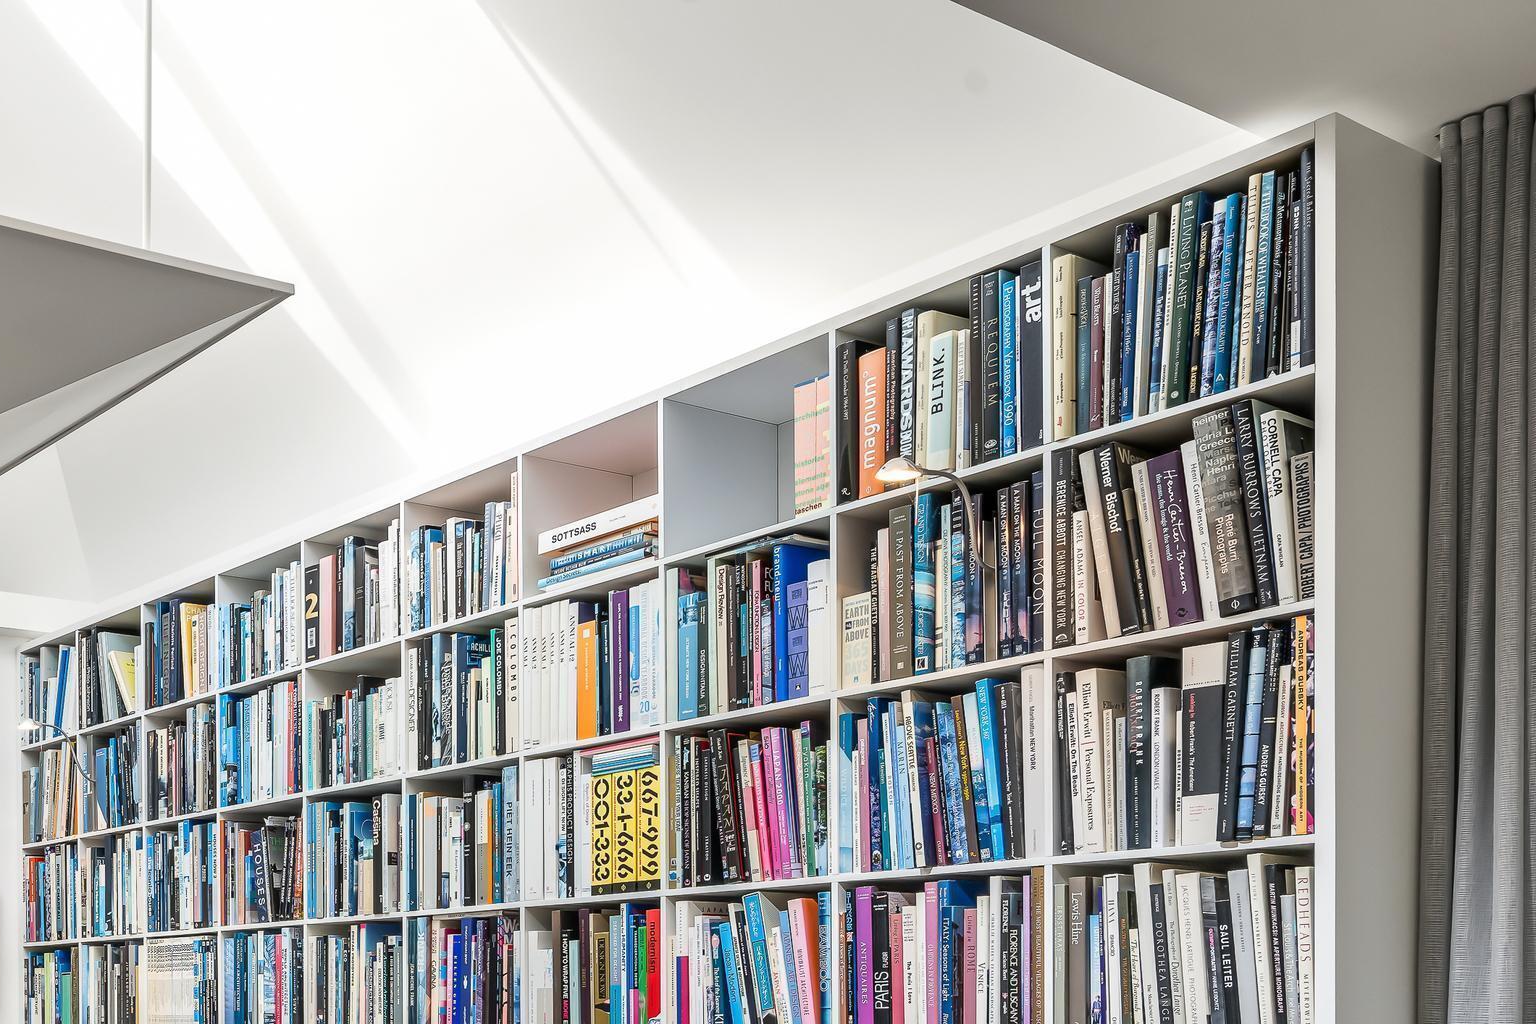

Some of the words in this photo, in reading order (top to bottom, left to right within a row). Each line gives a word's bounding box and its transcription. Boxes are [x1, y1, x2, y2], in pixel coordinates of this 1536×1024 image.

[1248, 185, 1257, 231] TULIPS
[1246, 250, 1254, 290] PETER
[1003, 286, 1012, 349] PHOTOGRAPHY
[1242, 295, 1253, 346] ARNOLD
[931, 347, 945, 415] BLINK.
[987, 317, 998, 406] REQUIEM
[1003, 350, 1013, 398] YEARBOOK
[1004, 401, 1014, 426] 1990
[1237, 409, 1252, 448] LARRY
[1099, 448, 1113, 488] Werner
[1243, 453, 1262, 518] BURROWS
[795, 502, 822, 515] taschen
[1105, 491, 1122, 534] Bischof
[1296, 462, 1312, 529] PHOTOGRAPHS
[551, 522, 597, 545] SOTTSASS
[1033, 509, 1044, 550] FULL
[1226, 513, 1235, 534] René
[1215, 517, 1228, 575] Photographs
[1227, 537, 1238, 562] Burri
[1252, 524, 1269, 586] VIETNAM
[1300, 538, 1313, 565] CAPA
[1032, 559, 1044, 616] MOON
[1302, 567, 1314, 600] ROBERT
[306, 593, 318, 620] 2
[845, 605, 869, 619] EARTH
[853, 619, 869, 630] FROM
[1078, 592, 1086, 621] COLOR
[845, 628, 869, 642] ABOVE
[1068, 703, 1076, 726] Elliott
[372, 799, 380, 846] Cassina
[253, 843, 266, 907] HOUSES
[1219, 924, 1229, 951] SAUL
[1297, 877, 1311, 963] REDHEADS
[819, 925, 827, 994] BAMBOO
[977, 962, 985, 994] VENICE
[1221, 954, 1233, 989] LEITER
[875, 971, 889, 1010] PARIS
